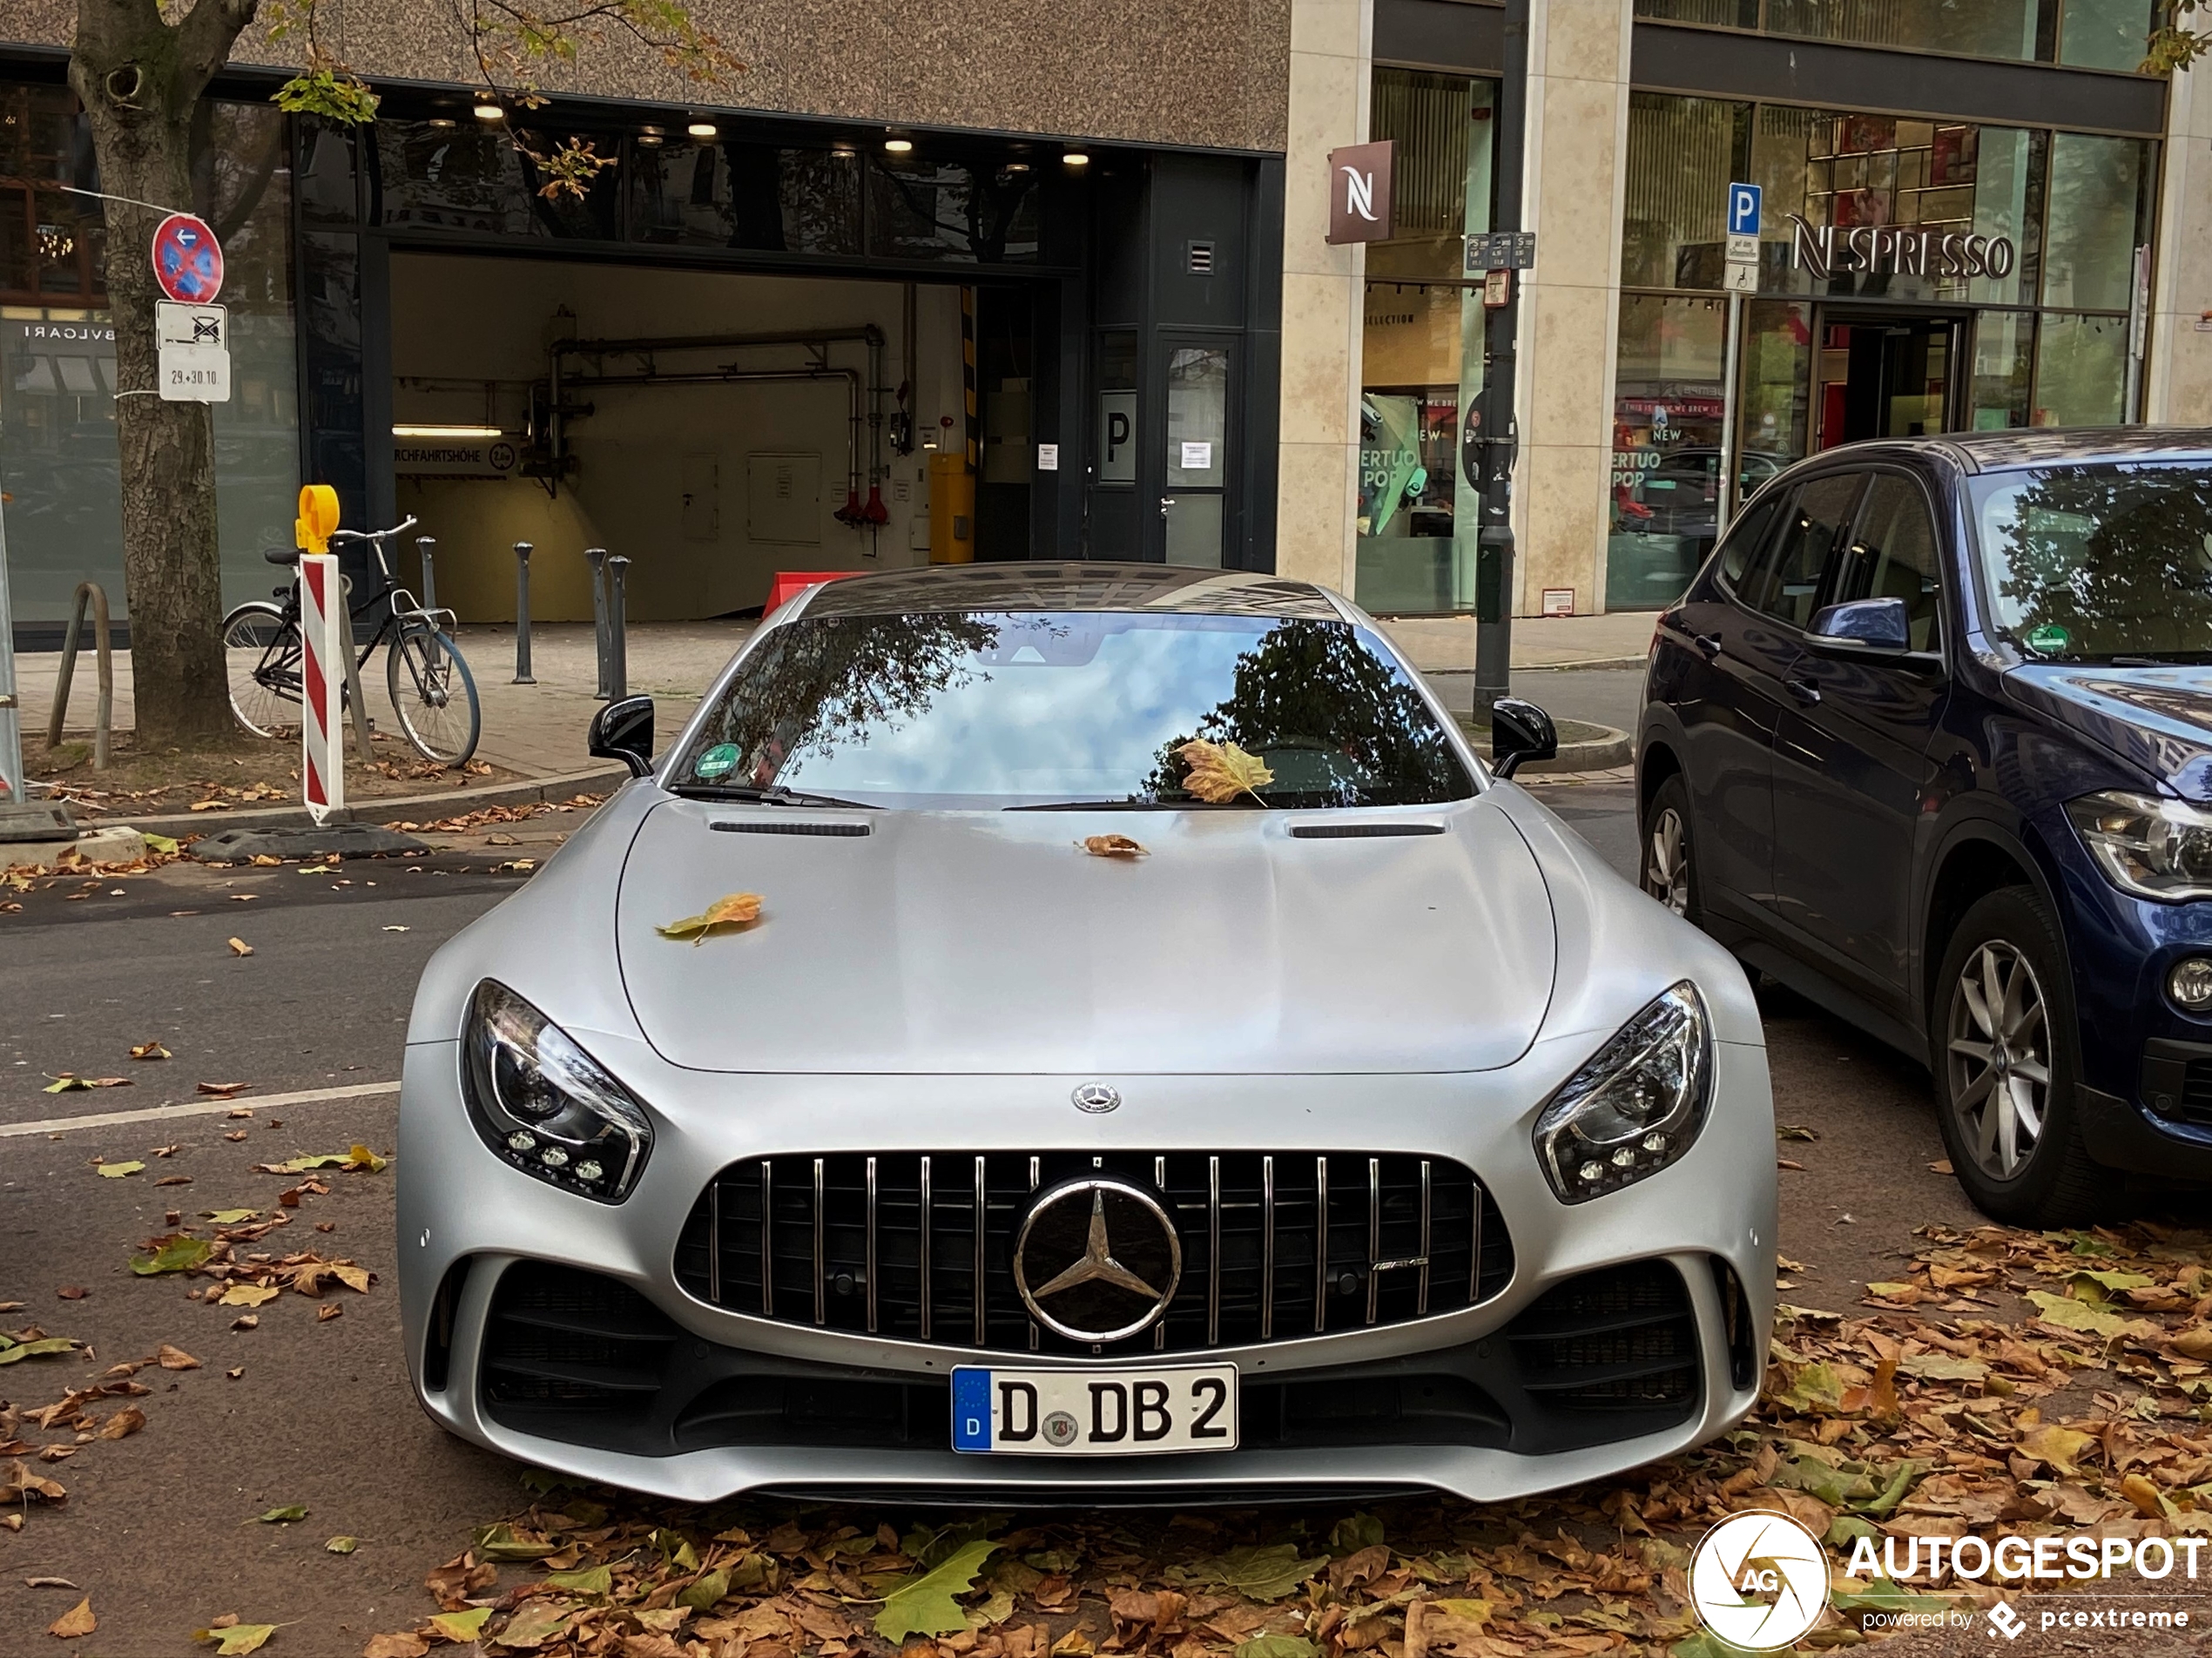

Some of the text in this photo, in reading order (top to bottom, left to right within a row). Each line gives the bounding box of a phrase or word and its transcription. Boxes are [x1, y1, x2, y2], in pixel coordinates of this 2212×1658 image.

[1339, 165, 1380, 221] N
[1736, 191, 1754, 230] P
[1784, 212, 2014, 280] NESPRESSO
[1108, 412, 1130, 462] P
[1420, 429, 1440, 441] EW
[1653, 429, 1682, 441] NEW
[395, 448, 481, 462] RCHFAHRTSHÖHE
[1360, 450, 1417, 467] ERTUO
[1612, 452, 1661, 468] ERTUO
[1612, 471, 1645, 488] POP
[998, 1381, 1038, 1441] D
[1089, 1380, 1172, 1443] DB
[1190, 1378, 1227, 1439] 2
[967, 1419, 980, 1435] D
